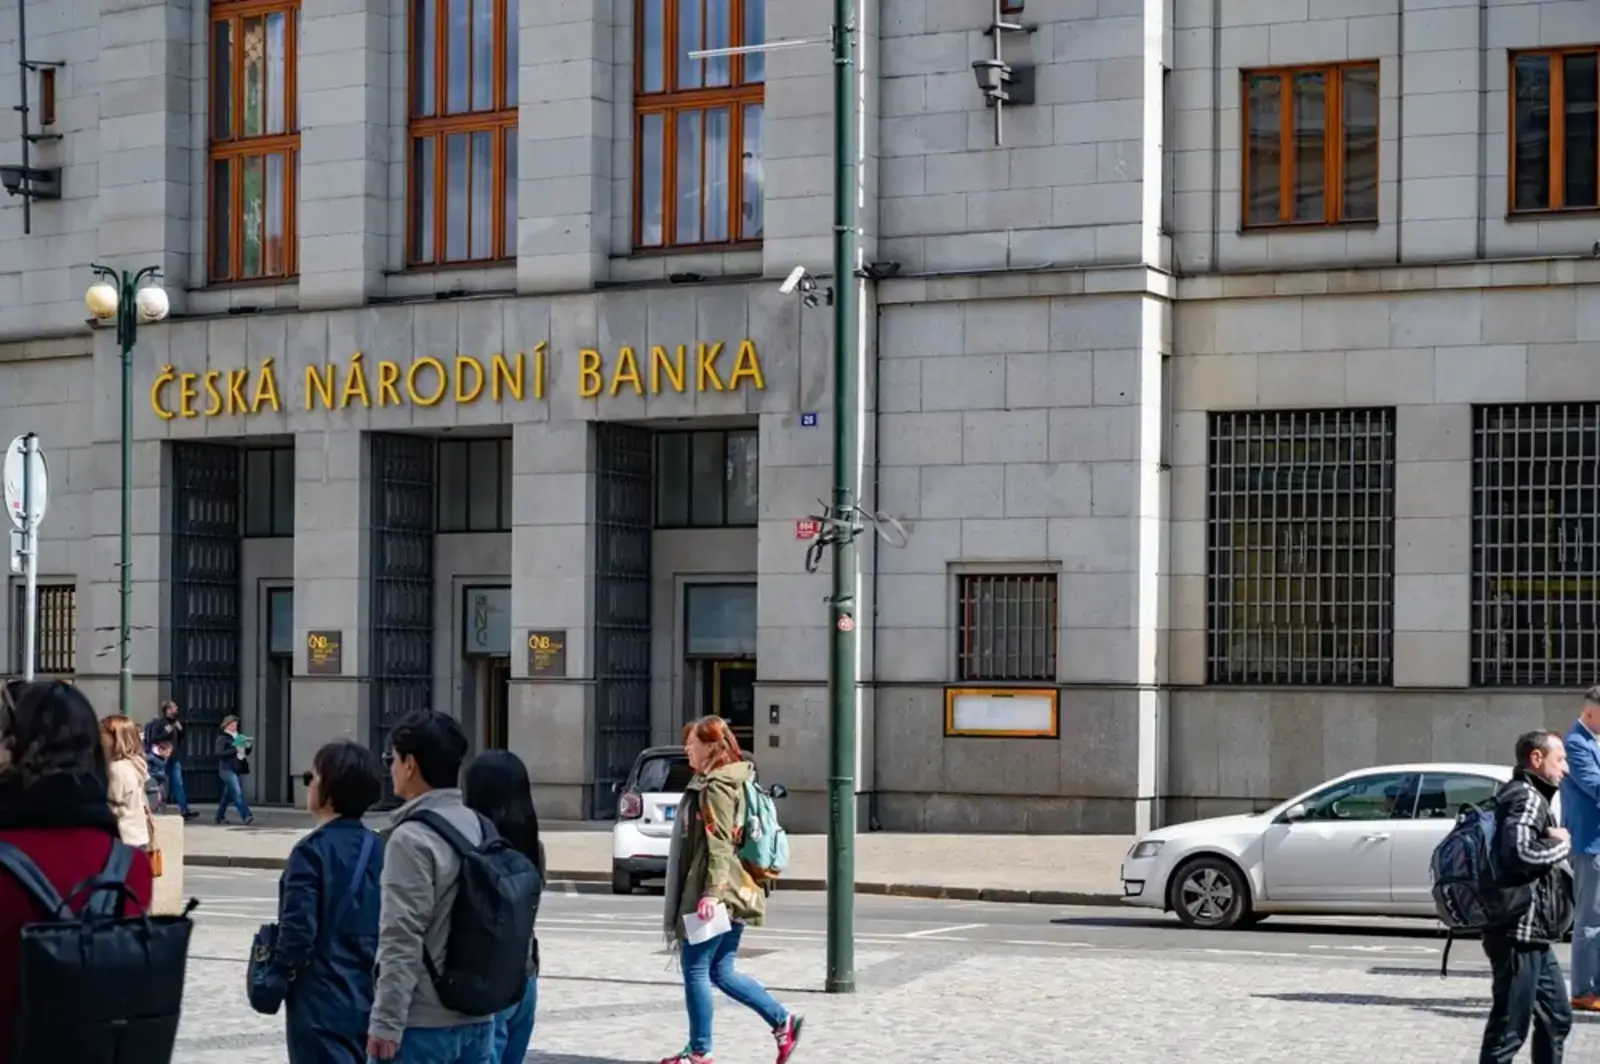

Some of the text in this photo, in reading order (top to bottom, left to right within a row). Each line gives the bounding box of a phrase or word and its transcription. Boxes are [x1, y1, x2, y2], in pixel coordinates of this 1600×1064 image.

[151, 340, 765, 419] ČESKÁ NÁRODNÍ BANKA
